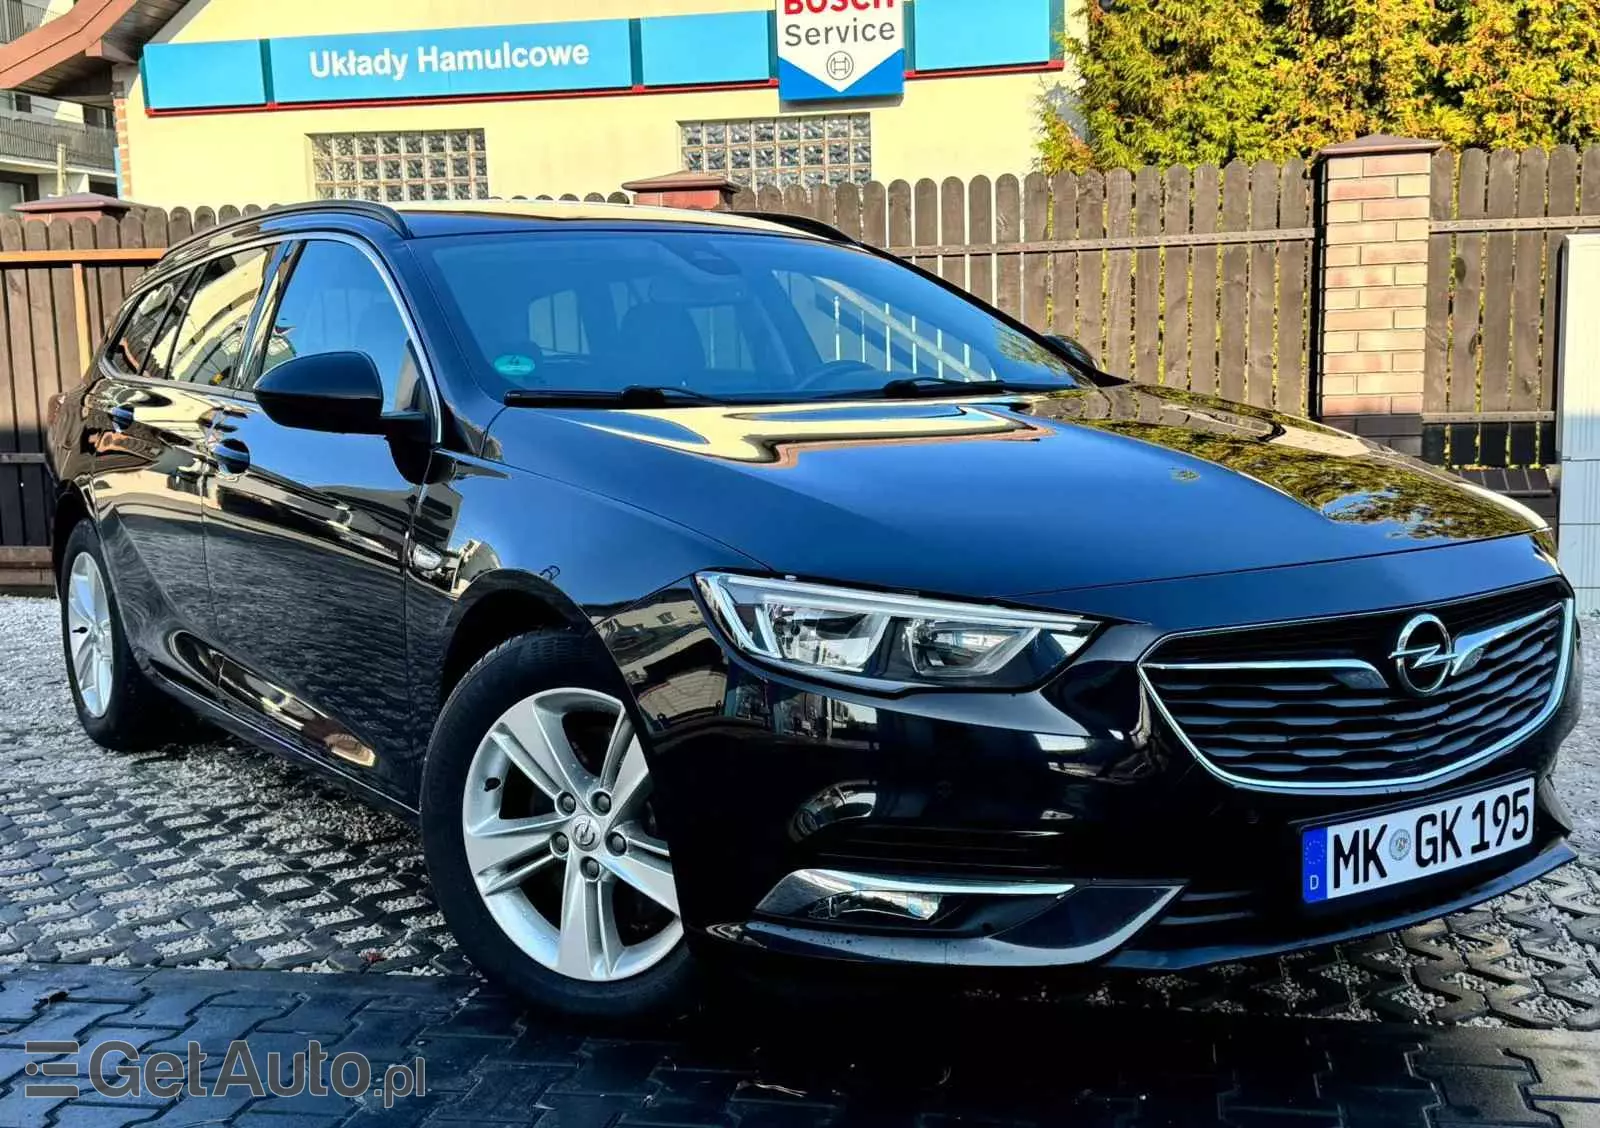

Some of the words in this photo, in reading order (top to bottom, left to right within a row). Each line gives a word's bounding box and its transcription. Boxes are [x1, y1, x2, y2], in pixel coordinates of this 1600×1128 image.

[784, 17, 896, 47] Service
[308, 47, 409, 81] Układy
[417, 42, 590, 73] Hamulcowe
[1333, 824, 1388, 889] MK
[1415, 806, 1463, 868] GK
[1470, 787, 1531, 855] 195
[1309, 874, 1319, 890] D
